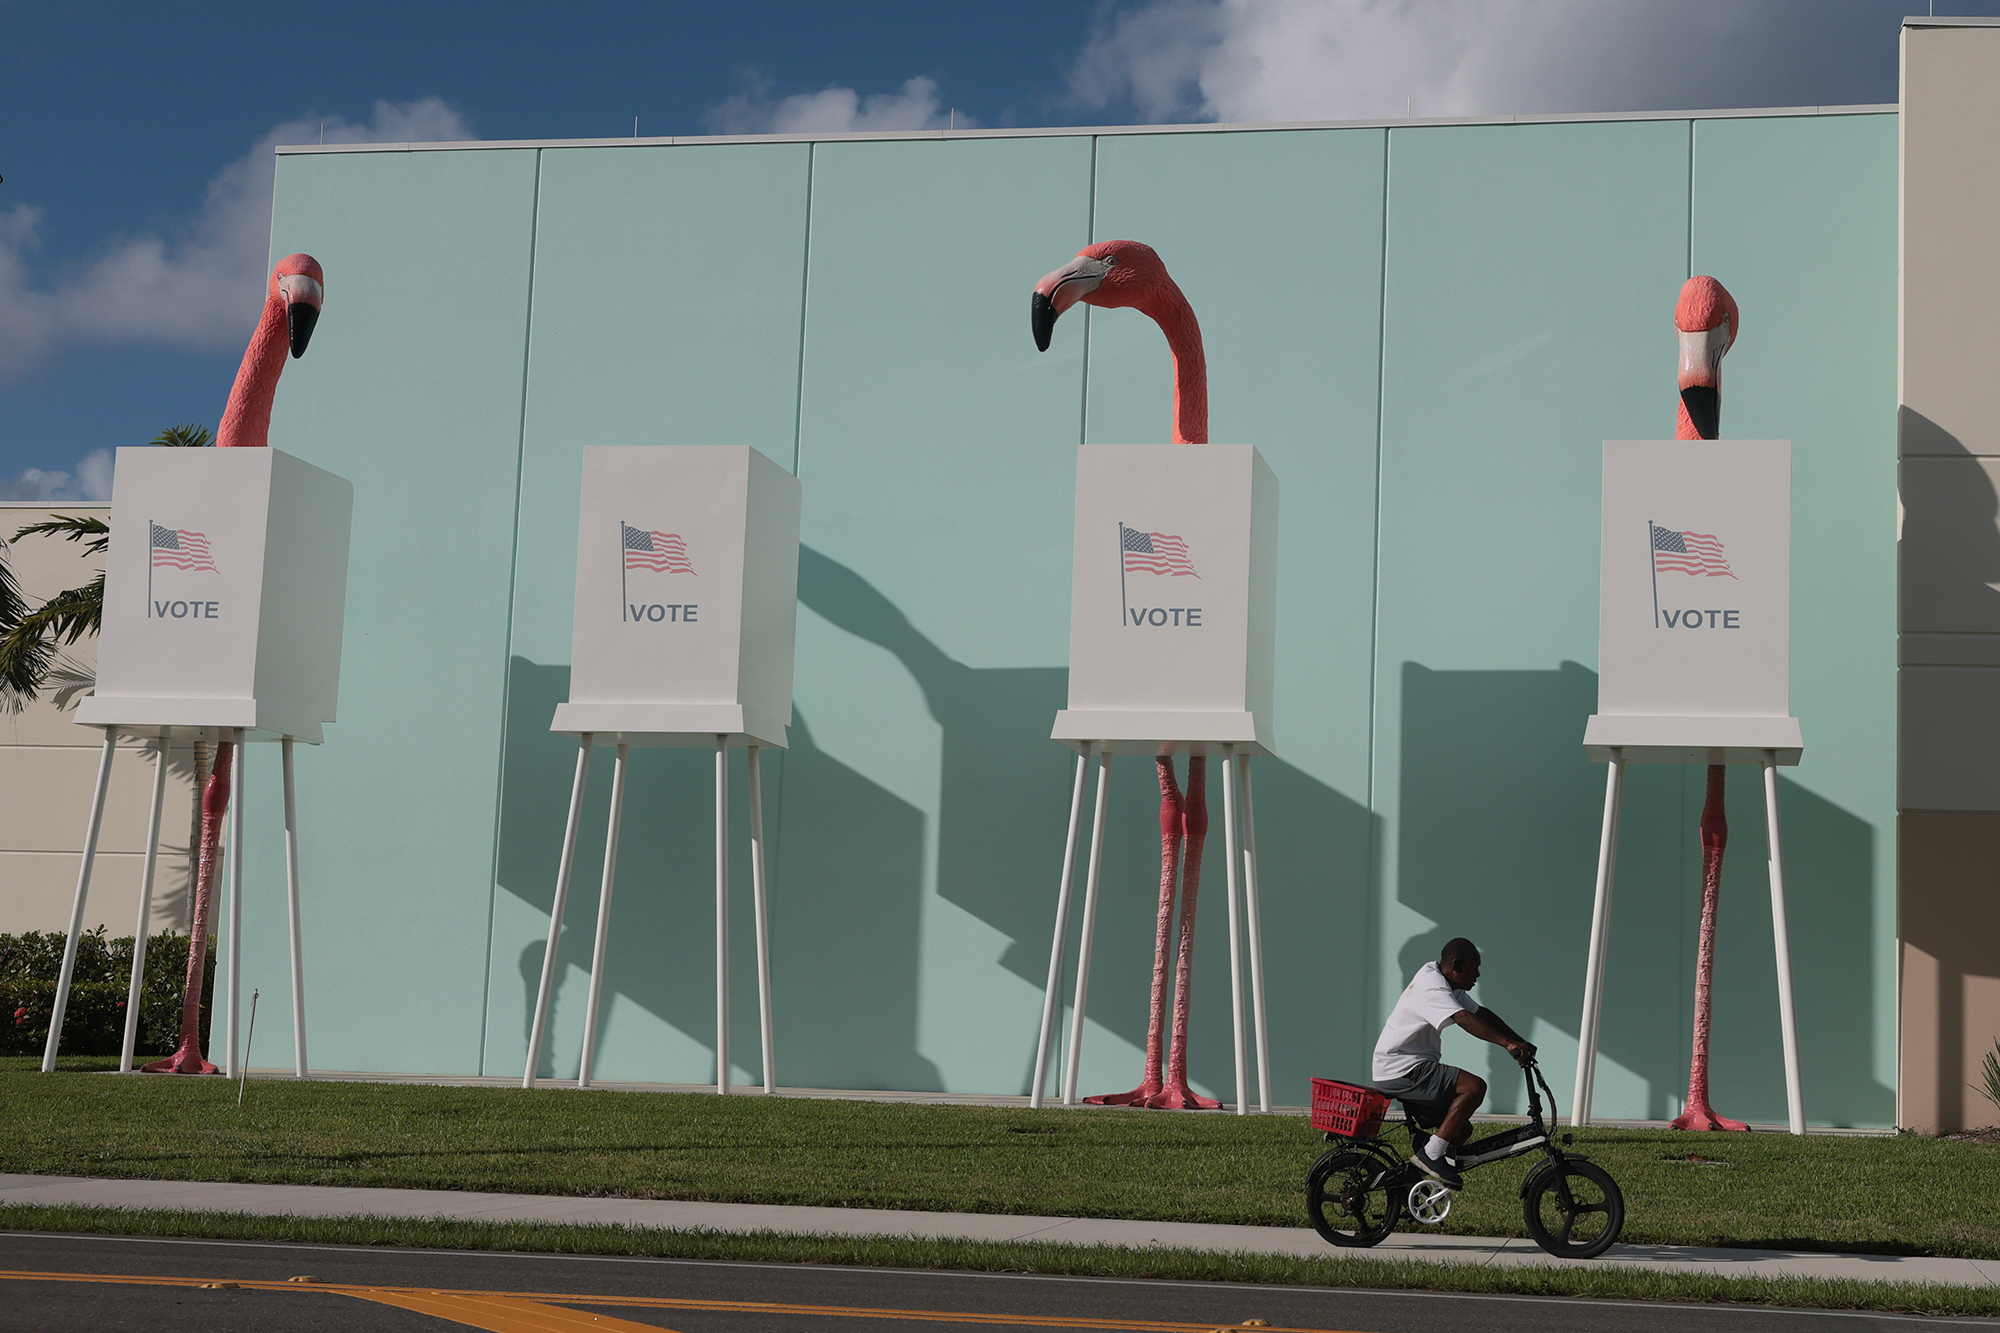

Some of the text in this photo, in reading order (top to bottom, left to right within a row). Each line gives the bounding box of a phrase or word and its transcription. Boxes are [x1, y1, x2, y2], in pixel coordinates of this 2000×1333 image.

[154, 601, 220, 618] VOTE
[629, 604, 699, 622] VOTE
[1129, 608, 1202, 626] VOTE
[1661, 609, 1741, 628] VOTE
